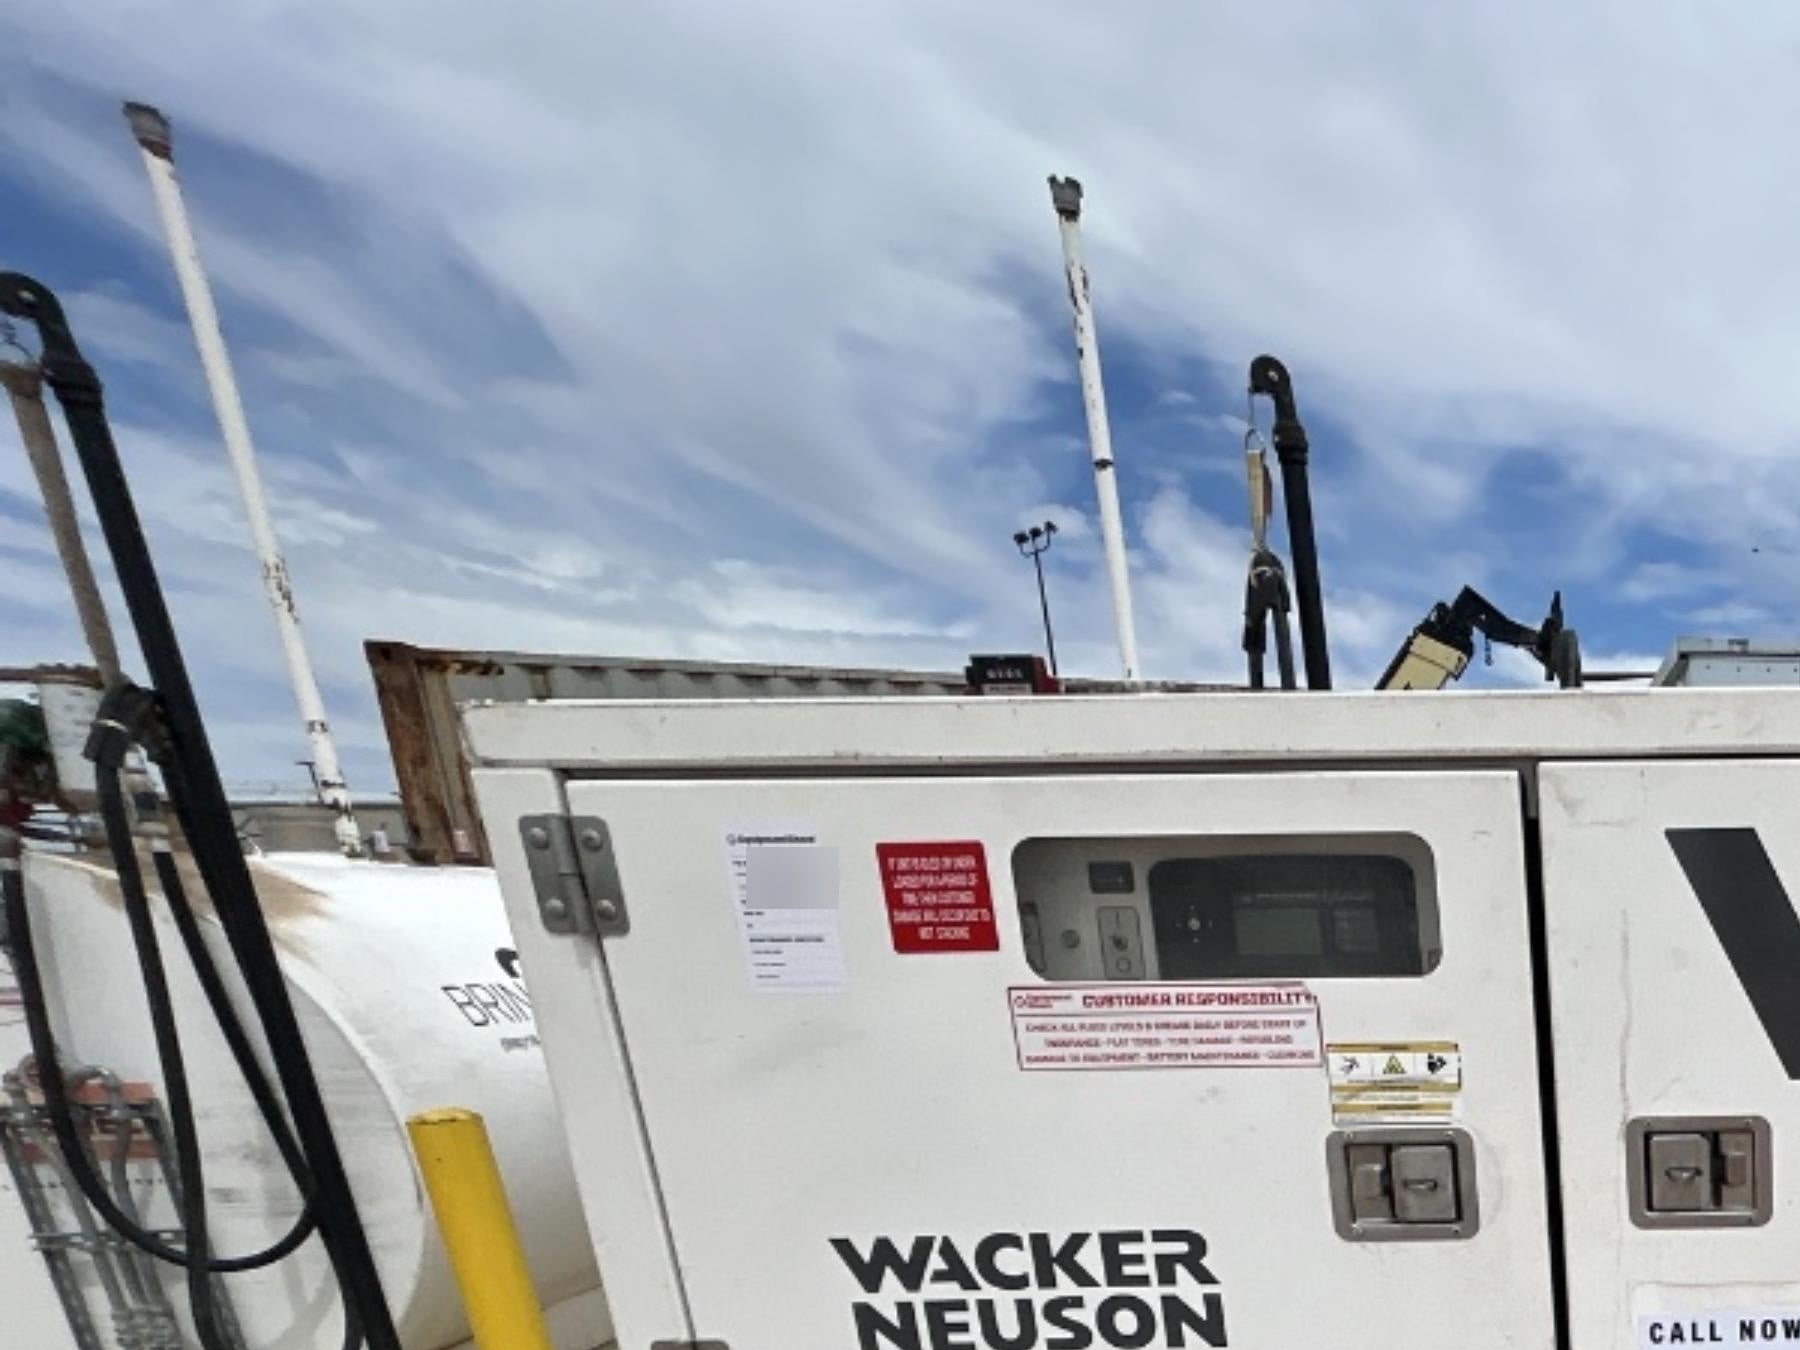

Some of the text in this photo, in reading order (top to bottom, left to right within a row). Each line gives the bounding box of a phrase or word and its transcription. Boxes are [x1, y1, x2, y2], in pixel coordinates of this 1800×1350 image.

[1081, 992, 1171, 1009] CUSTOMER
[828, 1229, 1222, 1294] WACKER
[1649, 1320, 1723, 1345] CALL
